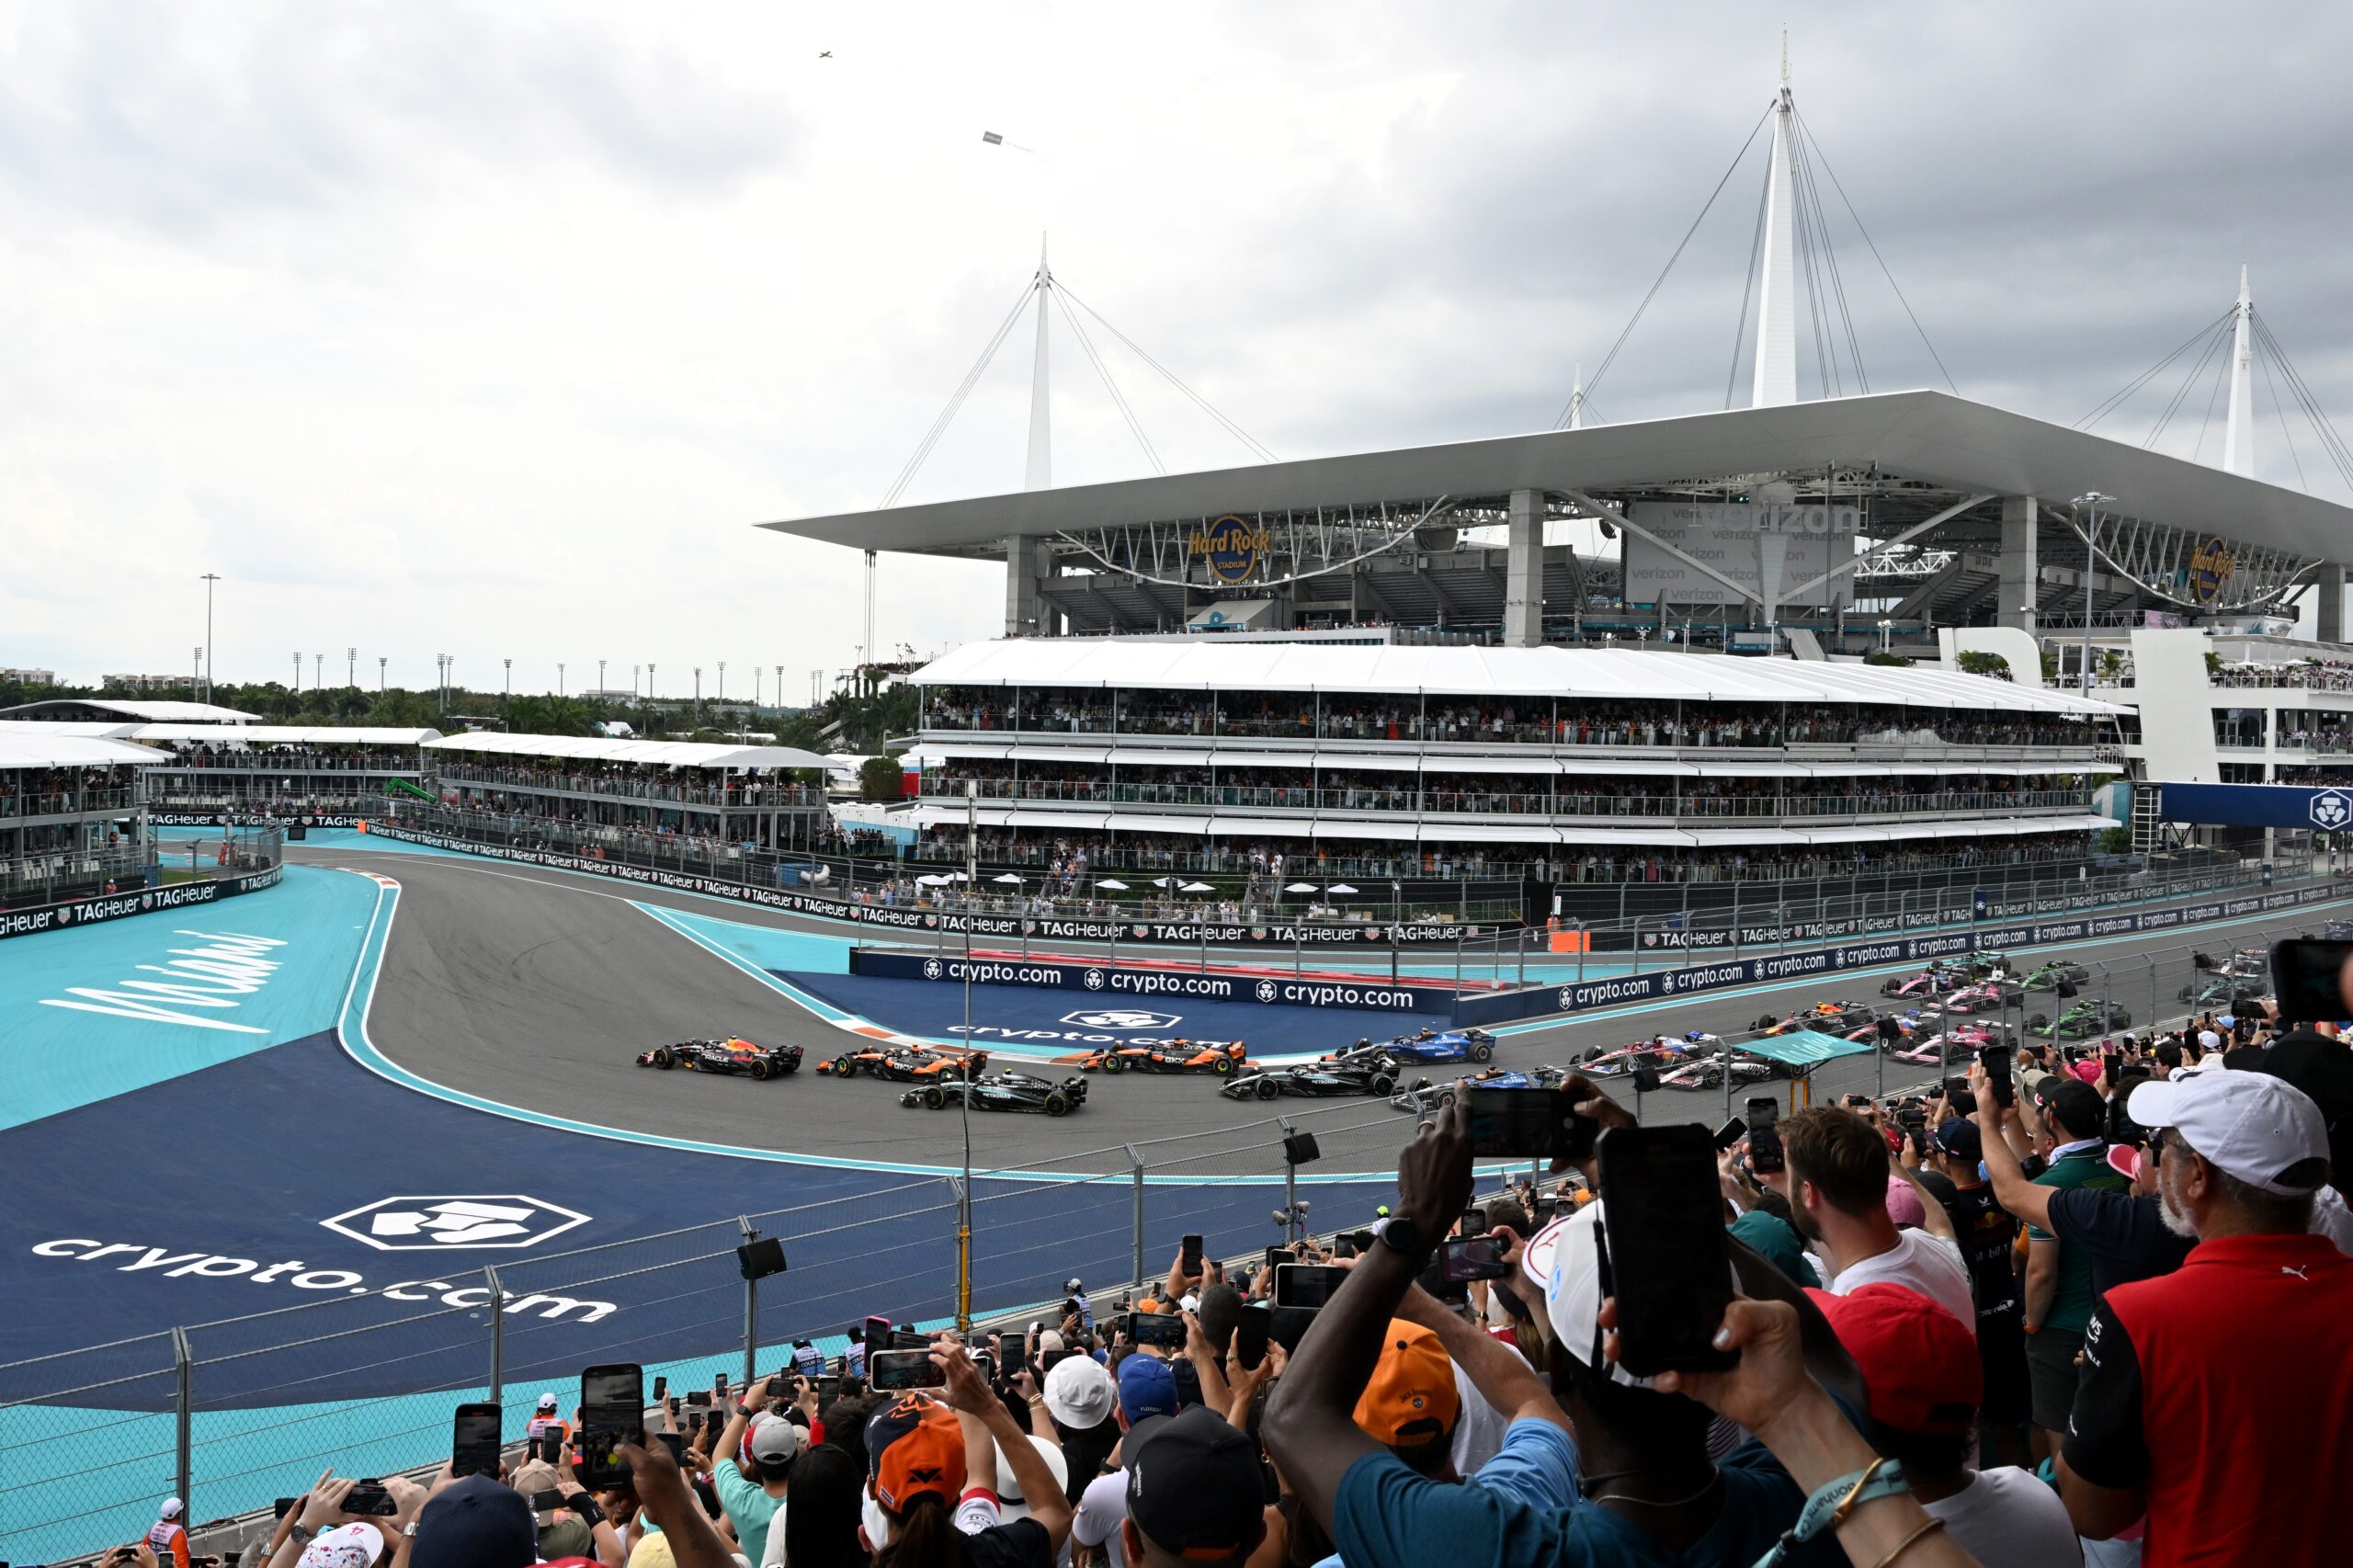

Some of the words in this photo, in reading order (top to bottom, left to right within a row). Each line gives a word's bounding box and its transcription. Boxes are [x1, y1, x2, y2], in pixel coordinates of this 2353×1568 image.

[1188, 529, 1229, 554] Hard
[1232, 527, 1272, 555] Rock
[1218, 561, 1246, 570] STADIUM
[1631, 567, 1685, 580] verizon
[1670, 587, 1724, 601] verizon
[2096, 918, 2131, 933] crypto.com
[2144, 912, 2177, 927] crypto.com
[1984, 931, 2026, 948] crypto.com
[2042, 924, 2081, 940] crypto.com
[1847, 944, 1899, 964] crypto.com
[1919, 937, 1966, 955] crypto.com
[1768, 953, 1825, 975] crypto.com
[949, 963, 1061, 984] crypto.com
[1678, 966, 1743, 989] crypto.com
[1111, 972, 1232, 995] crypto.com
[1285, 985, 1413, 1007] crypto.com
[1576, 980, 1650, 1005] crypto.com
[701, 1053, 729, 1062] ORACLE
[918, 1051, 942, 1060] Chrome
[1165, 1056, 1185, 1064] OKX
[31, 1238, 618, 1323] crypto.com
